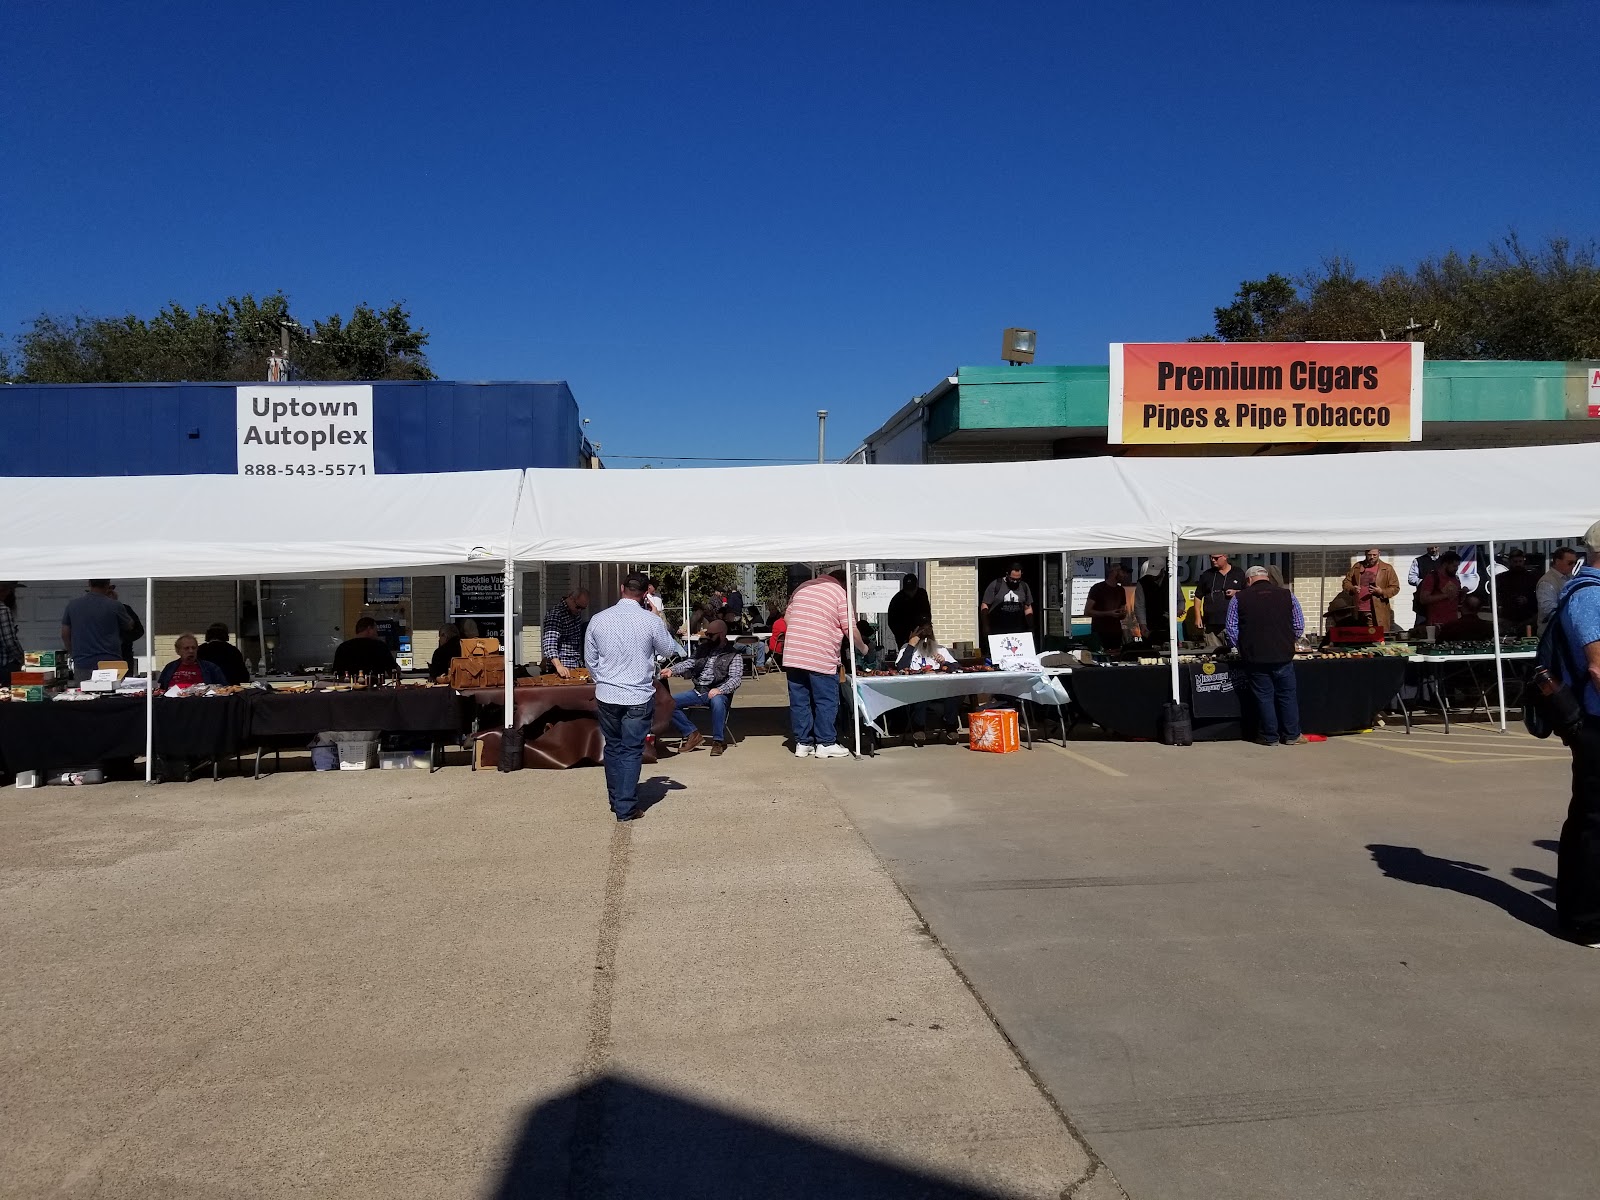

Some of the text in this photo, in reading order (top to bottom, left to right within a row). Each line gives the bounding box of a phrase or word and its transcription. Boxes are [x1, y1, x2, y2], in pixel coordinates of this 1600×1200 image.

[1157, 360, 1379, 394] Premium Cigars
[252, 397, 358, 423] Uptown
[1143, 402, 1391, 431] Pipes & Pipe Tobacco
[243, 423, 368, 451] Autoplex
[244, 464, 366, 476] 888-543-5571
[462, 584, 493, 592] Services
[490, 575, 505, 584] Val
